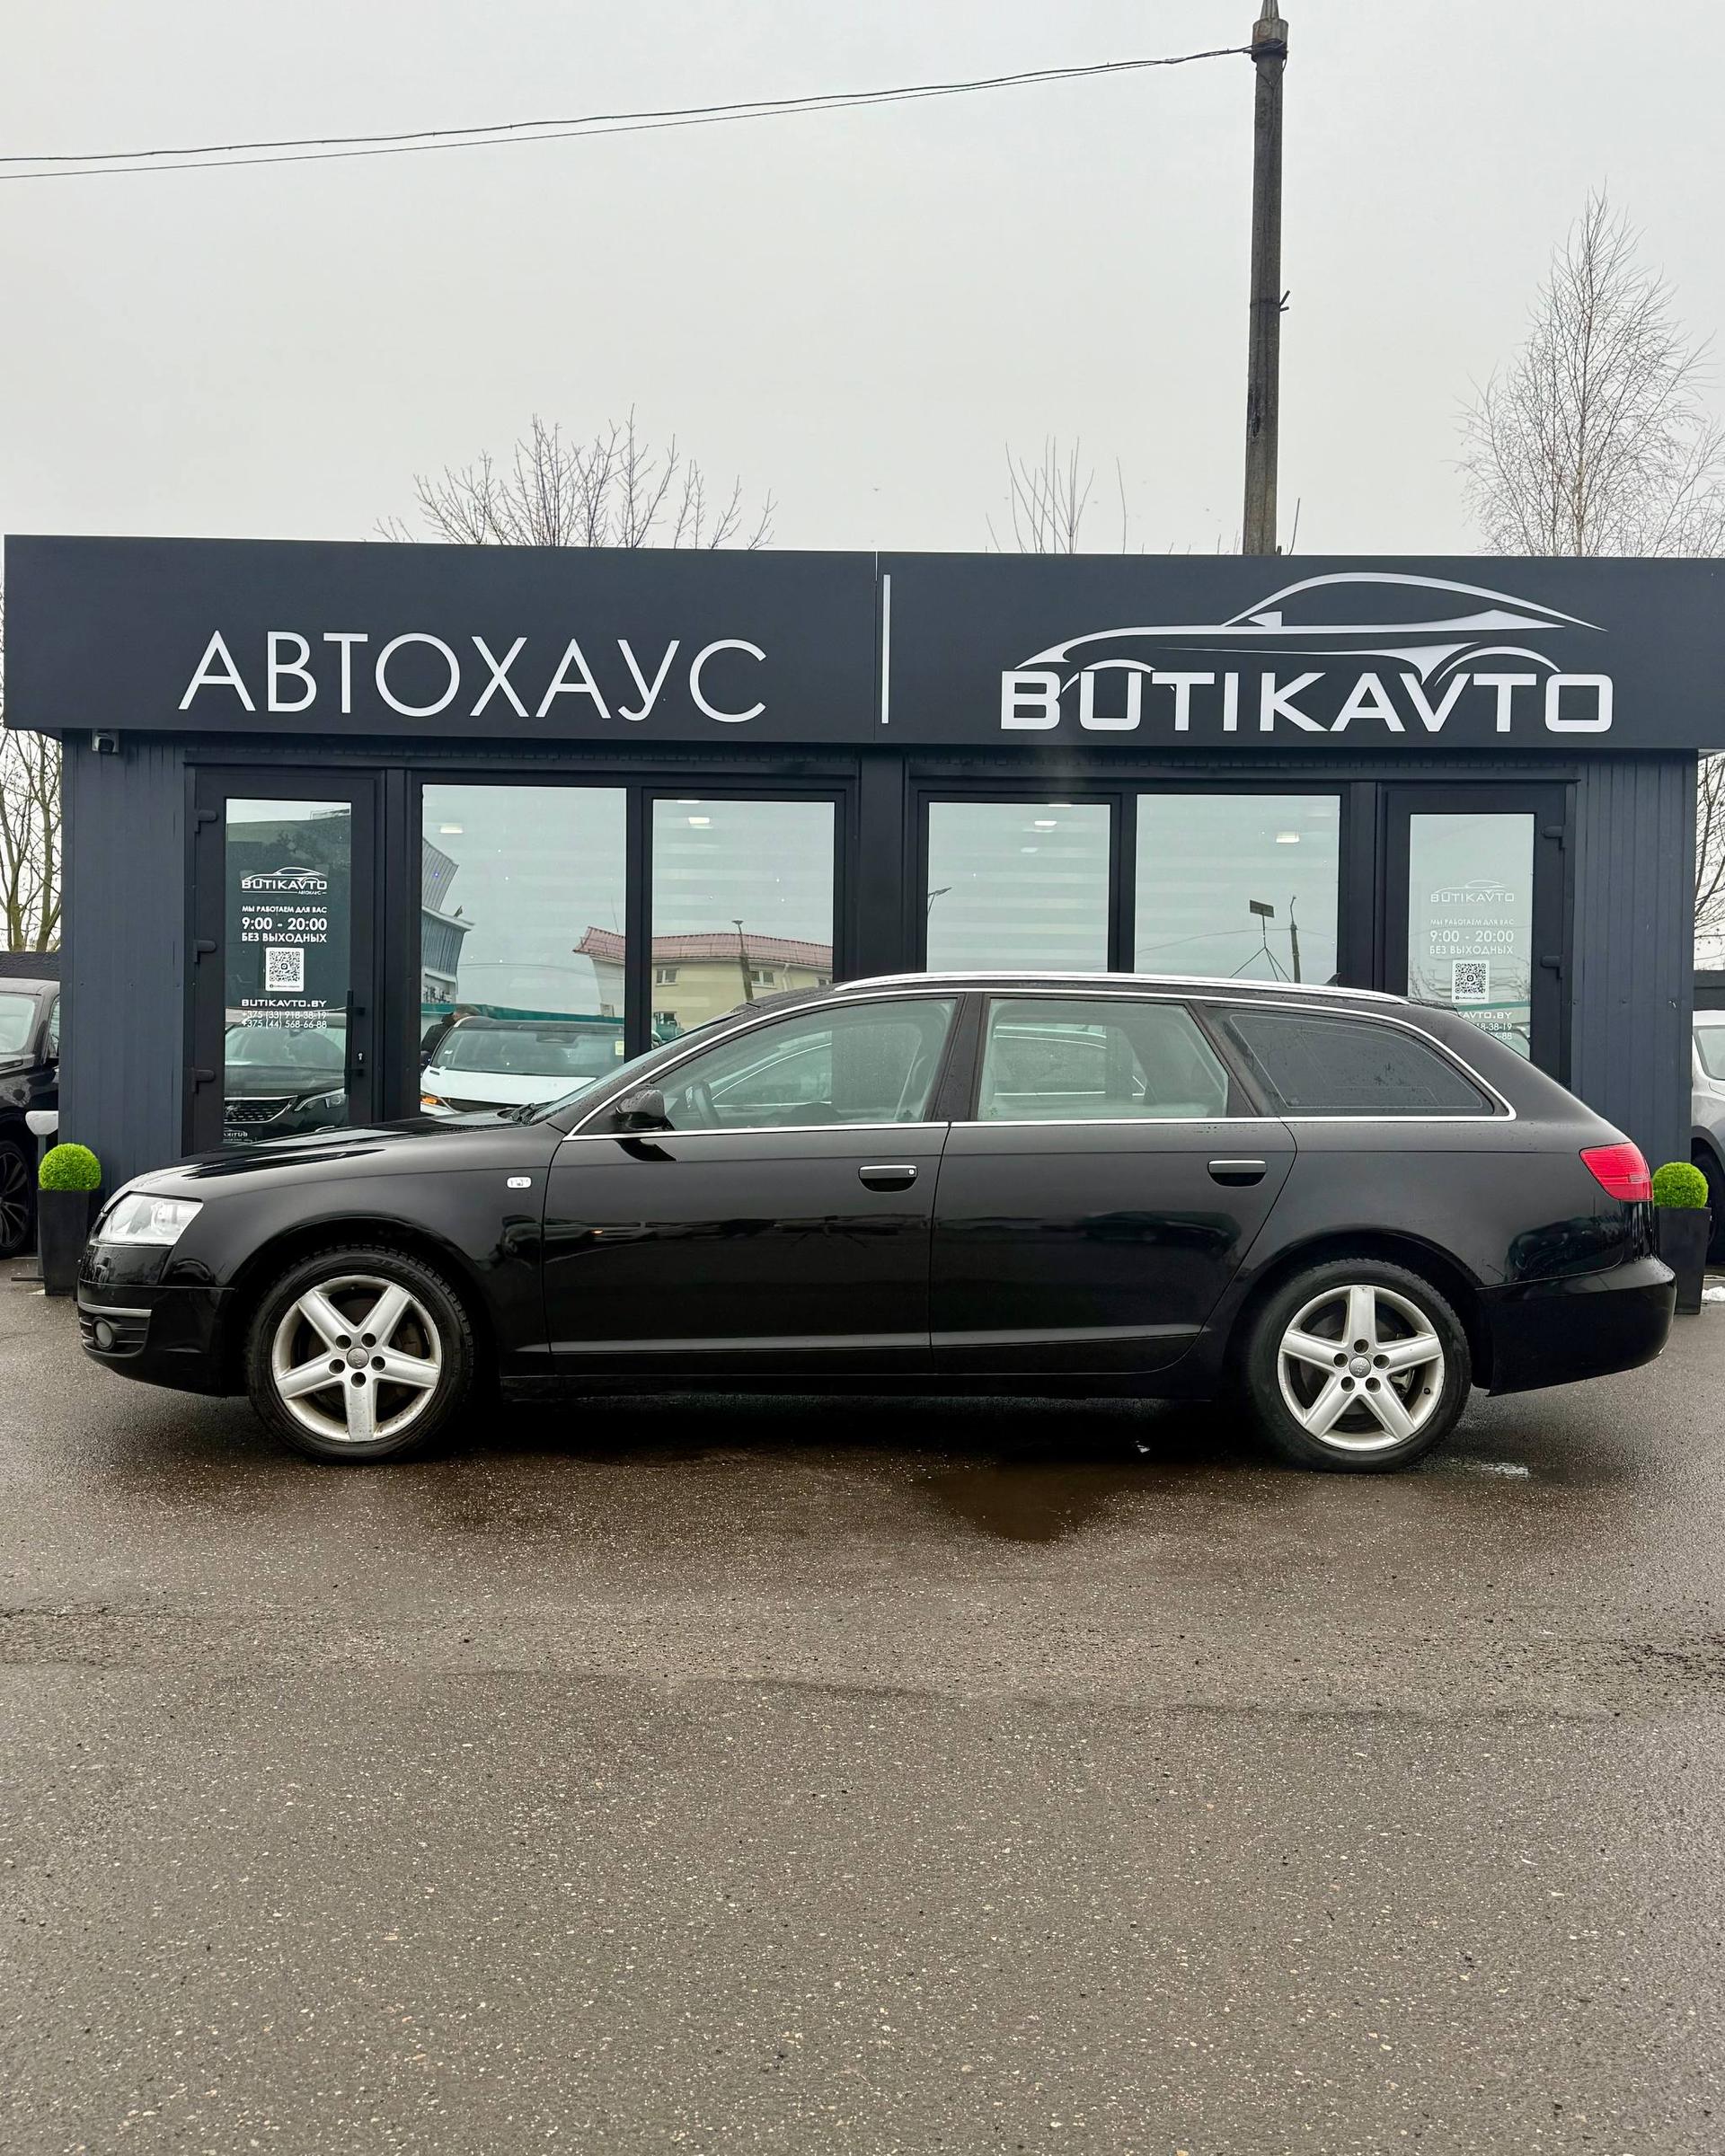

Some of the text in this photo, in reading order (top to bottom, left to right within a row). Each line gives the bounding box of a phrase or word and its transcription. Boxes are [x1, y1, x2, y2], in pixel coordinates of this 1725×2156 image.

[178, 630, 768, 722] АВТОХАУС
[1001, 670, 1614, 733] BUTIKAVTO
[241, 879, 328, 890] BUTIKAVTO
[1430, 892, 1515, 903] BUTIKAVTO
[257, 906, 295, 914] РАБОТАЕМ
[242, 917, 273, 931] 9:00
[288, 917, 328, 931] 20:00
[242, 932, 327, 943] БЕЗ ВЫХОДНЫХ
[1430, 930, 1460, 942] 9:00
[1475, 930, 1515, 943] 20:00
[1430, 946, 1514, 955] БЕЗ ВЫХОДНЫХ
[241, 999, 327, 1008] BUTIKAVTO.BY
[241, 1011, 263, 1020] +375
[266, 1011, 282, 1021] (33)
[241, 1020, 328, 1029] +375 (44) 568-66-88
